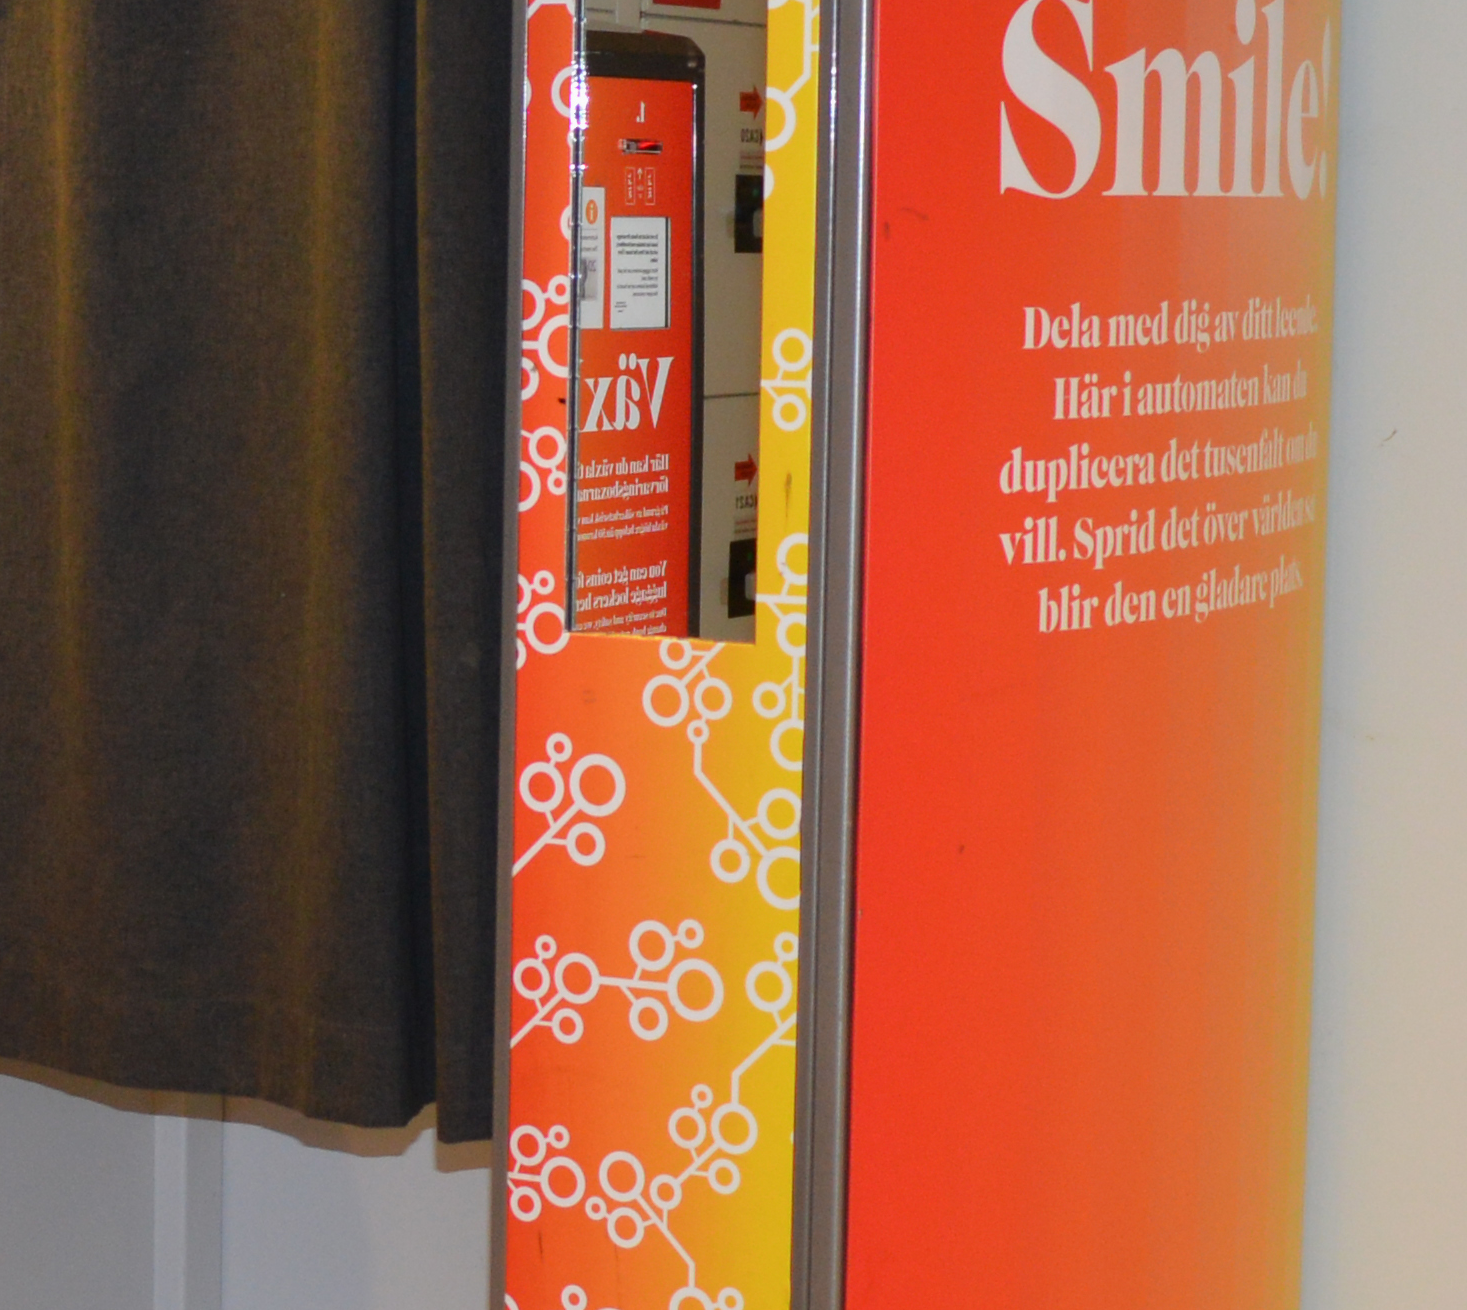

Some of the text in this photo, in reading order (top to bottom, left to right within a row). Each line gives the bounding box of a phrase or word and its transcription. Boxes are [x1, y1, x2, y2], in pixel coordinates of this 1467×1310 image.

[1022, 301, 1102, 350] Dela
[1107, 299, 1169, 347] med
[1174, 298, 1210, 353] dig
[1214, 310, 1239, 342] av
[1242, 296, 1273, 341] ditt
[1053, 372, 1118, 420] Här
[1122, 369, 1132, 417] i
[1137, 369, 1260, 416] automaten
[1263, 362, 1291, 405] kan
[999, 441, 1156, 503] duplicera
[1160, 437, 1200, 483] det
[1203, 427, 1284, 479] tusenfalt
[998, 515, 1067, 566] vill.
[1073, 507, 1156, 570] Sprid
[1160, 505, 1201, 552] det
[1203, 501, 1249, 546] över
[1251, 489, 1304, 537] världen
[1037, 583, 1099, 634] blir
[1104, 579, 1157, 627] den
[1161, 584, 1191, 619] en
[1194, 563, 1268, 624] gladare
